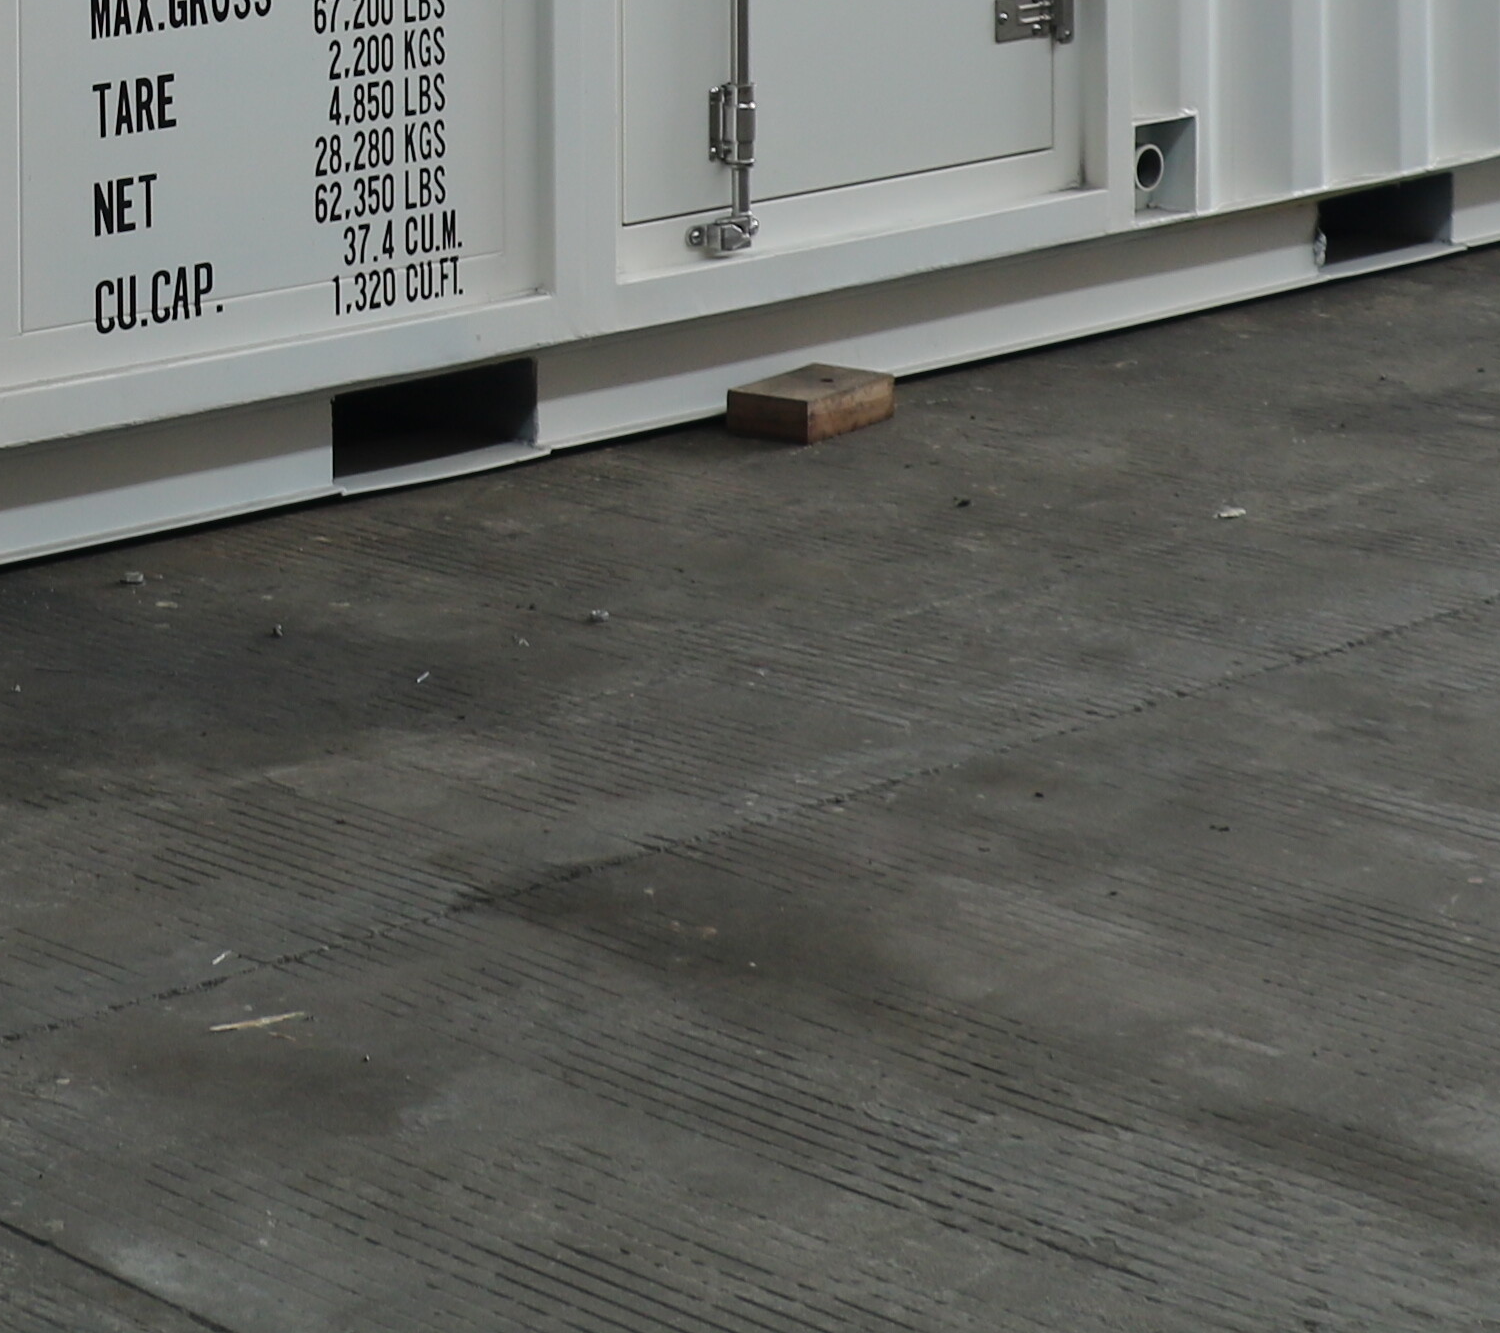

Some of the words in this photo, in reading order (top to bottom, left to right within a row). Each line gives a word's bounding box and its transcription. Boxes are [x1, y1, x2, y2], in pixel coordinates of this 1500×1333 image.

[328, 33, 394, 80] 2,200
[404, 26, 446, 70] KGS
[92, 73, 177, 138] TARE
[328, 80, 394, 126] 4,850
[404, 73, 446, 117] LBS
[314, 127, 394, 177] 28,280
[404, 119, 446, 163] KGS
[93, 173, 158, 237] NET
[314, 173, 395, 223] 62,350
[404, 166, 447, 210] LBS
[343, 219, 394, 266] 37.4
[405, 209, 463, 255] CU.M.
[94, 262, 224, 334] CU.CAP.
[332, 267, 396, 316] 1,320
[406, 256, 464, 303] CU.FT.
